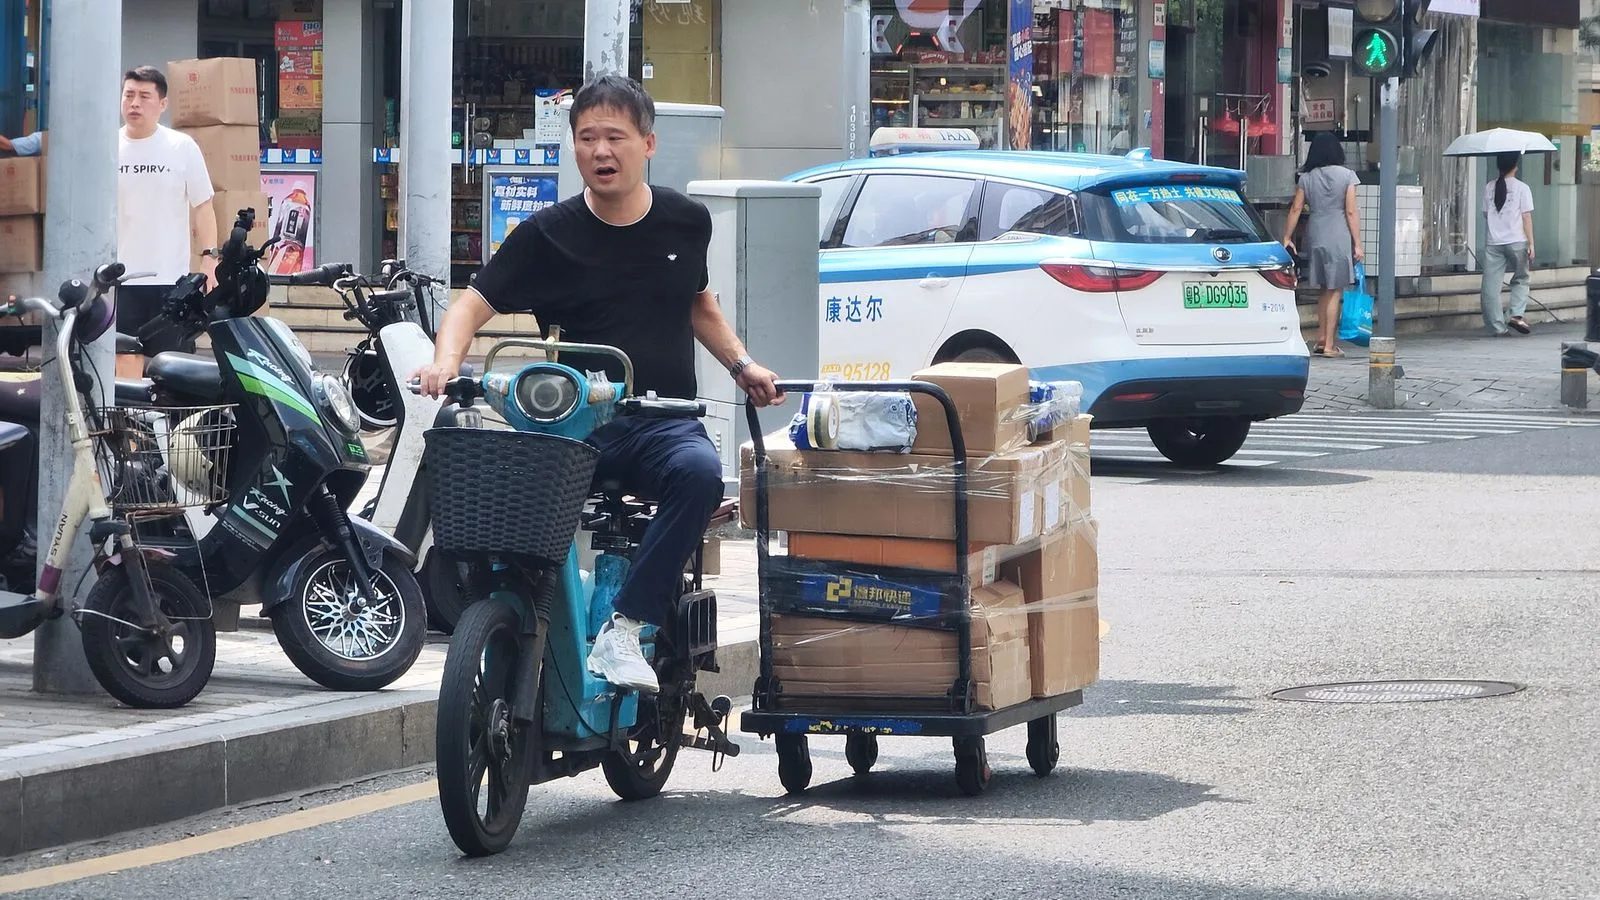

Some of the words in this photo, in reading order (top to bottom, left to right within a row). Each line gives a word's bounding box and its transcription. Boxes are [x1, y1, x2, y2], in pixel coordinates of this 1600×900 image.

[825, 295, 883, 323] 康达尔
[1186, 285, 1200, 304] 粤B
[1206, 285, 1248, 304] DG9035
[247, 348, 295, 385] Racing
[843, 362, 891, 381] 95128
[249, 486, 289, 517] Racing
[50, 513, 68, 556] SYUAN
